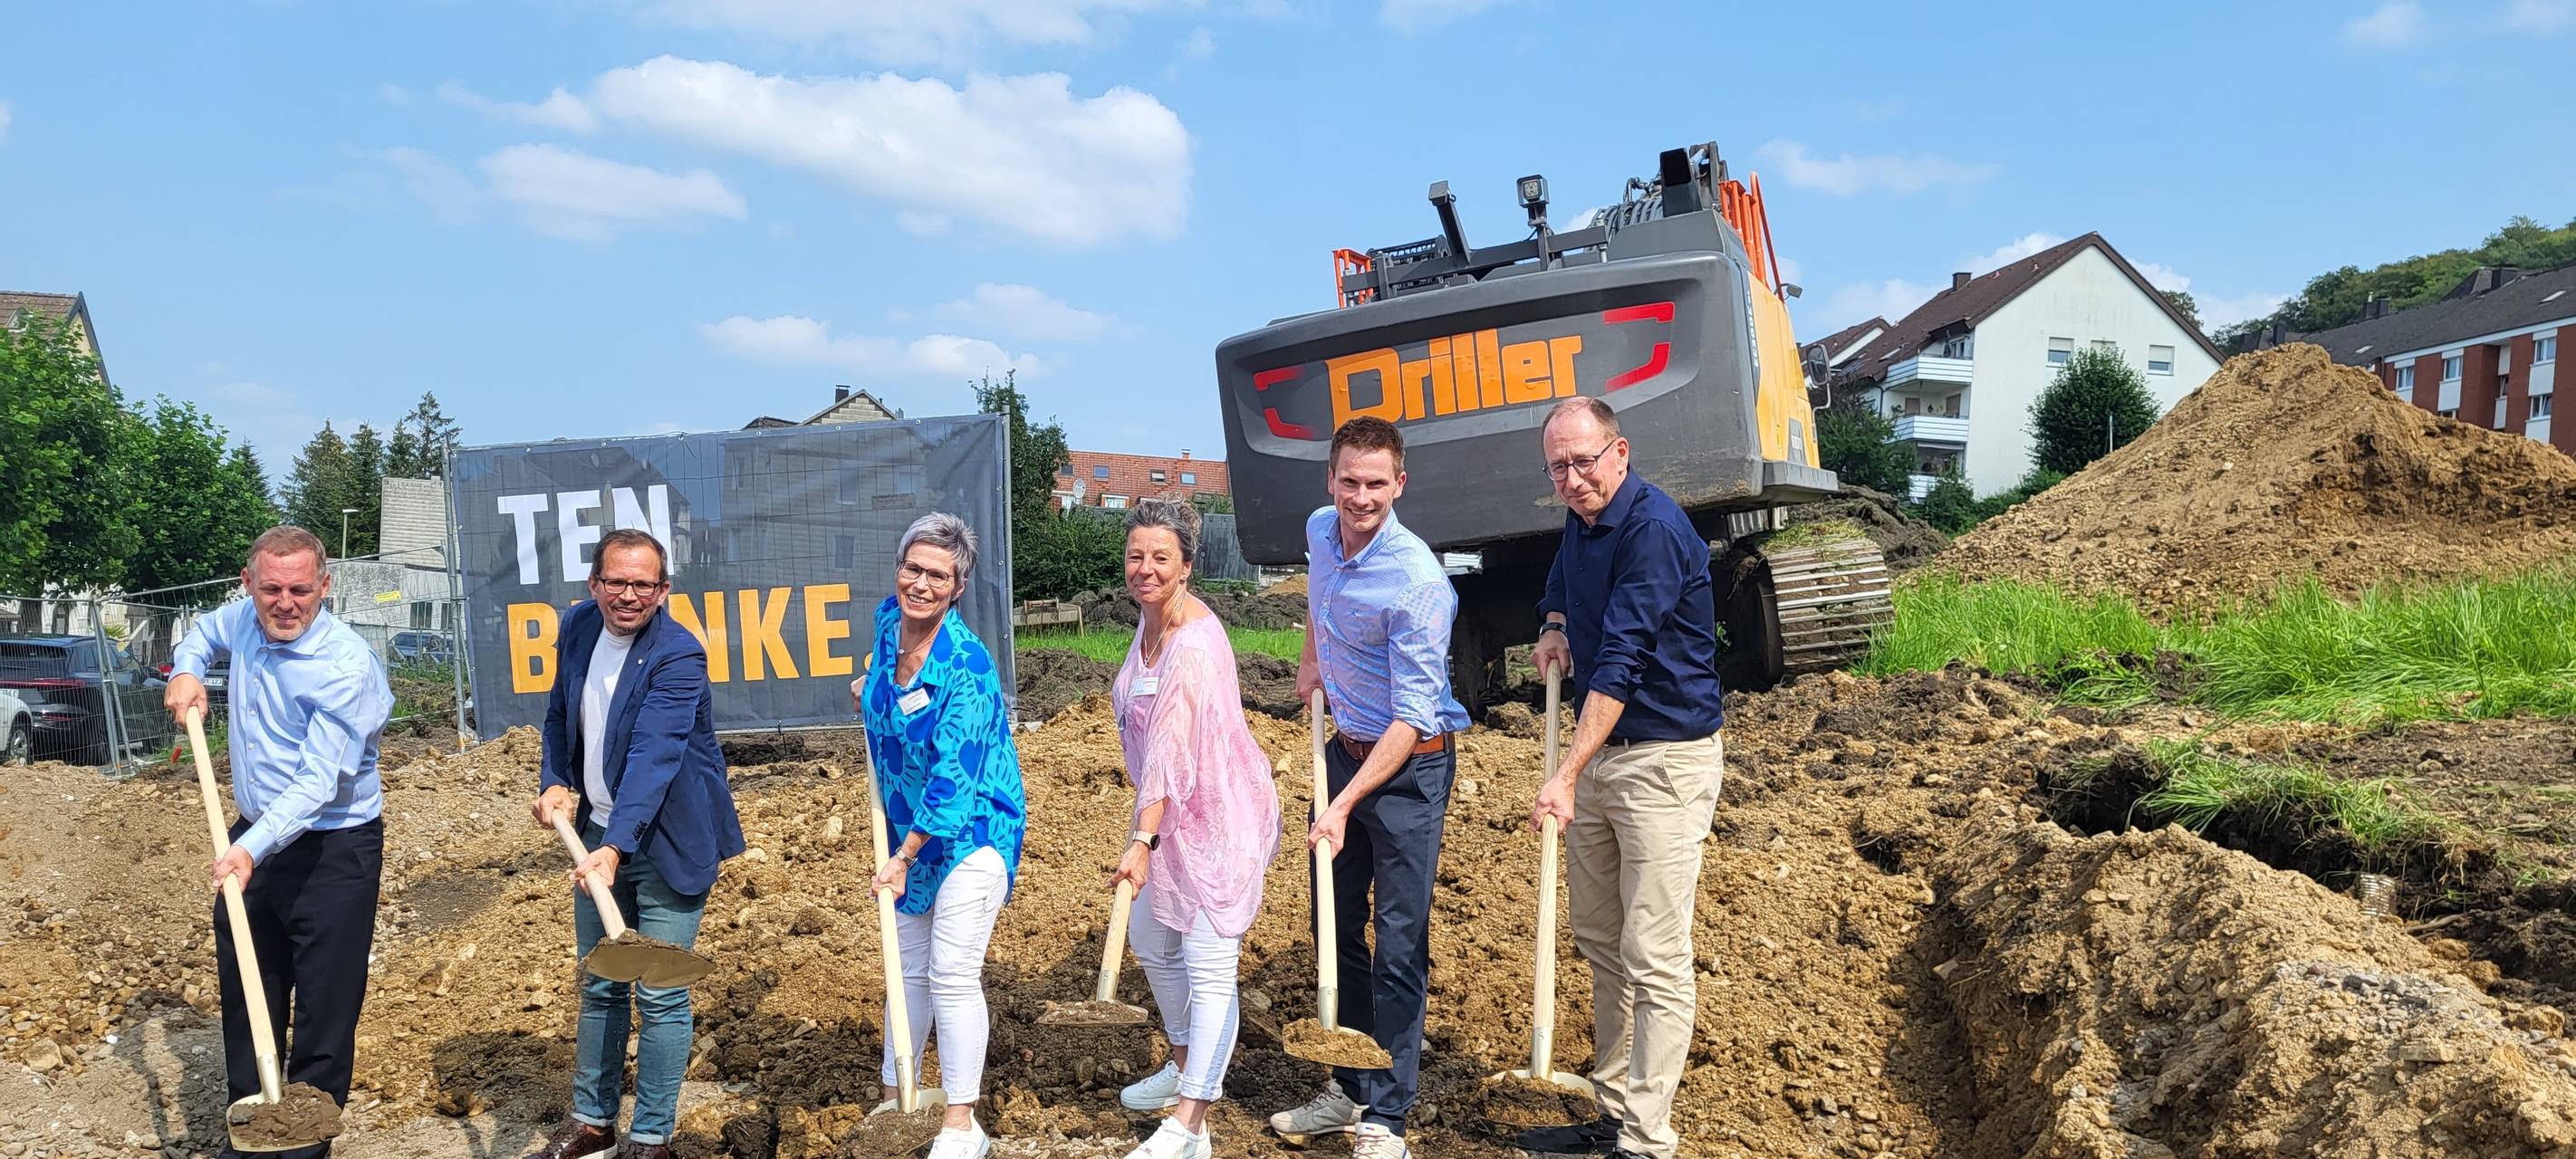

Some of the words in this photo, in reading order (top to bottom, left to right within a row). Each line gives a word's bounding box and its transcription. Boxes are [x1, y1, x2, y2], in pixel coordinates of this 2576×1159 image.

[1325, 329, 1582, 435] Driller
[497, 484, 675, 585] TEN
[507, 583, 873, 694] BNKE
